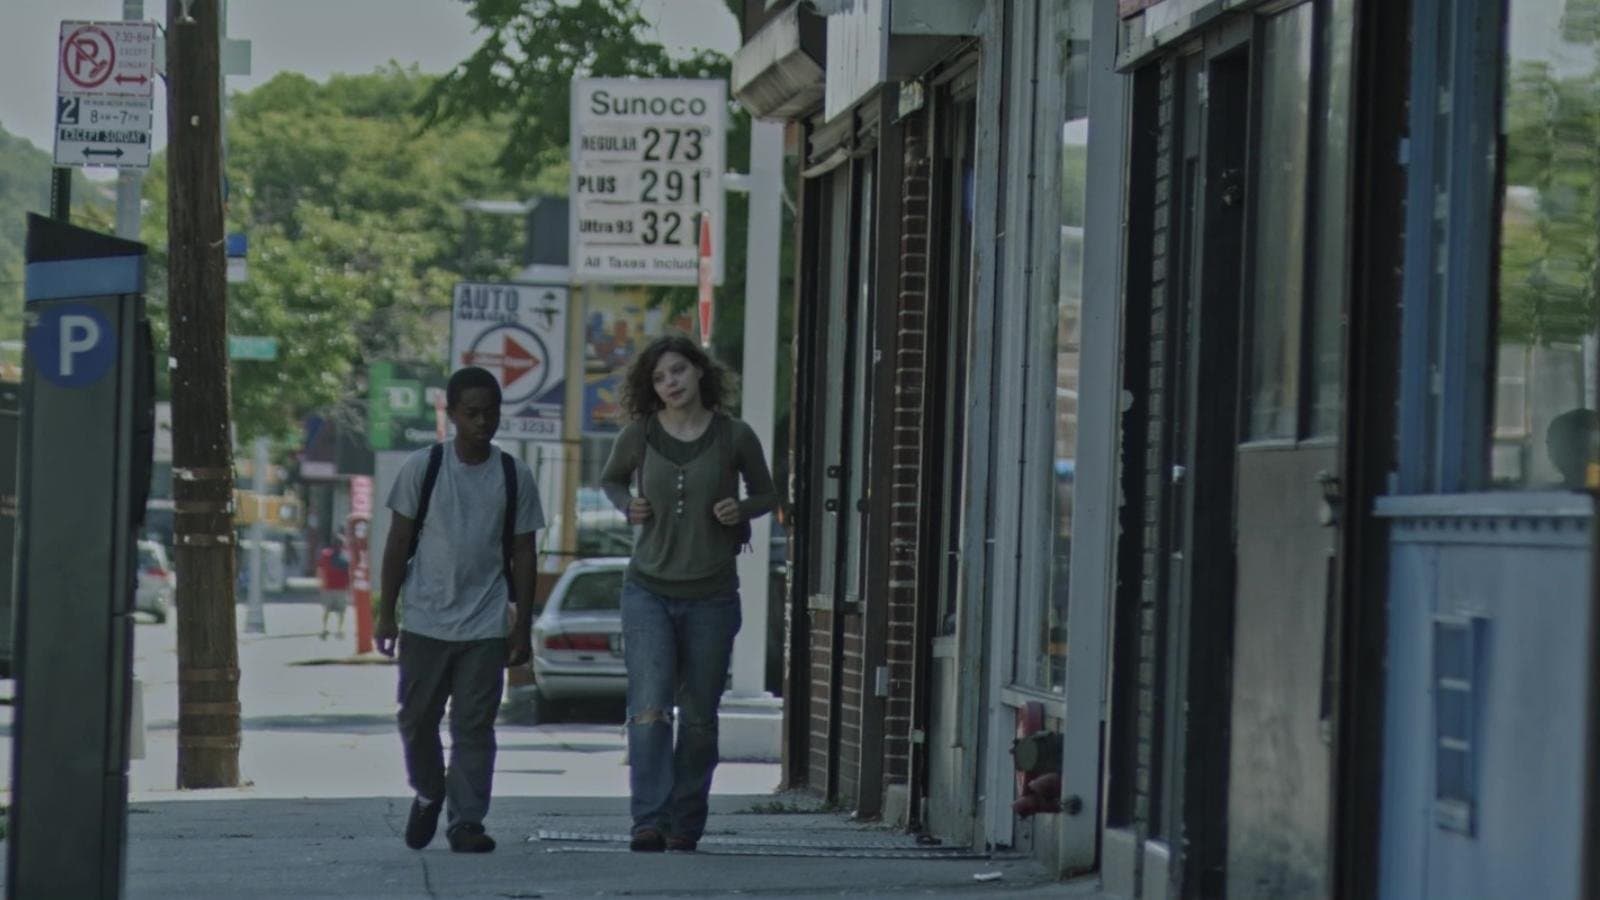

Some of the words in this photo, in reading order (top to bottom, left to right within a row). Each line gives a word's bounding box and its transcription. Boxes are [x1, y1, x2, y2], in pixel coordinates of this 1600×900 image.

[61, 97, 76, 123] 2
[590, 90, 706, 116] Sunoco
[64, 129, 97, 142] EXCEPT
[104, 130, 142, 143] SUNDAY
[580, 135, 637, 152] REGULAR
[577, 175, 617, 194] PLUS
[579, 219, 613, 234] Ultra
[616, 219, 634, 234] 93
[641, 210, 702, 246] 321
[585, 255, 601, 268] All
[609, 256, 647, 269] Taxes
[459, 286, 520, 312] AUTO
[59, 313, 100, 376] P
